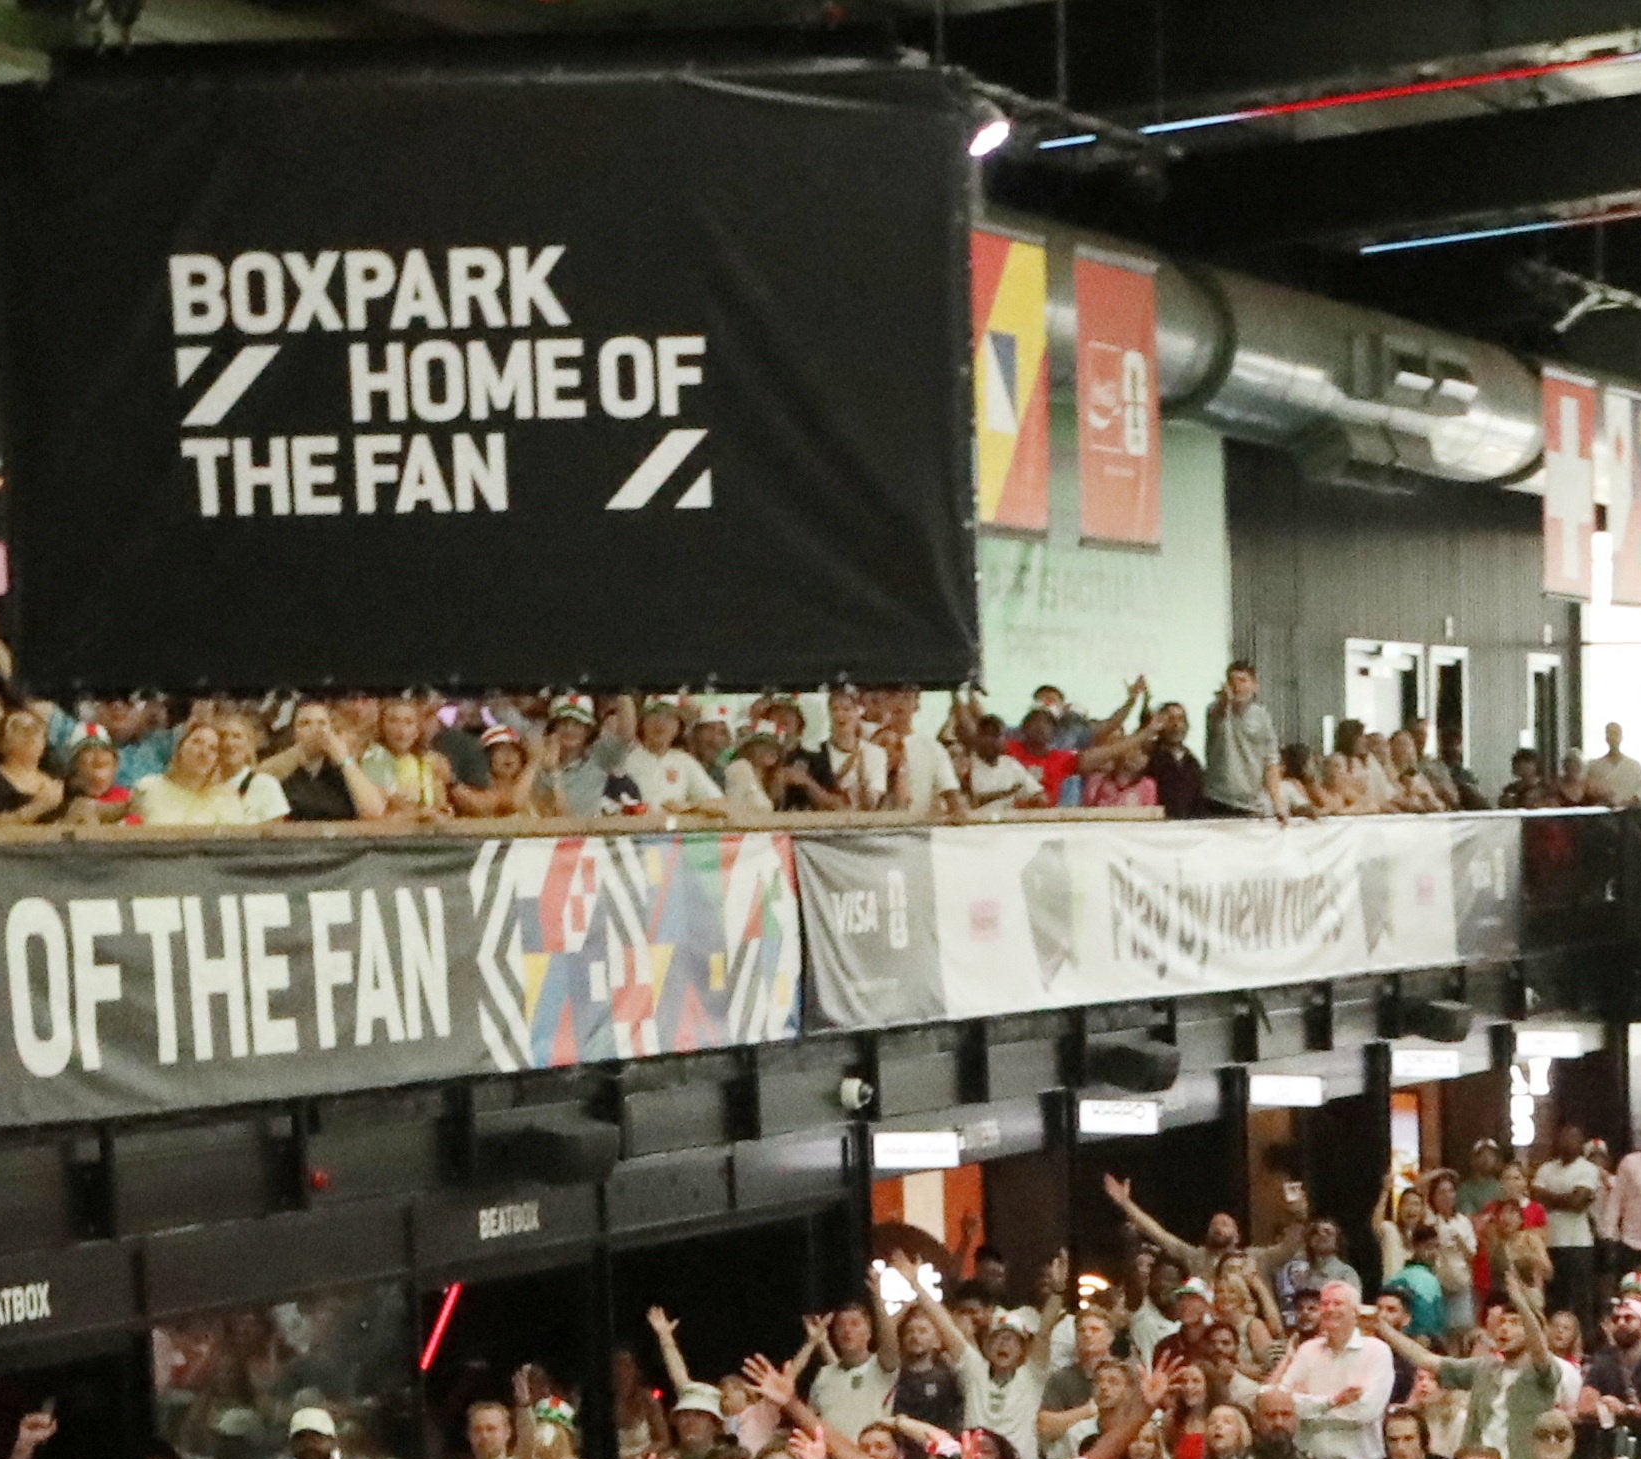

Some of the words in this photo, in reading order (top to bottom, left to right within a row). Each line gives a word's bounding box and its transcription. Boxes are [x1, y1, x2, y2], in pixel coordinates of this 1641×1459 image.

[168, 245, 572, 335] BOXPARK
[349, 338, 587, 423] HOME
[598, 335, 707, 420] OF
[180, 435, 342, 517] THE
[353, 432, 509, 514] FAN
[833, 890, 879, 934] VISA
[4, 896, 123, 1079] OF
[132, 892, 299, 1065] THE
[308, 886, 451, 1049] FAN
[479, 1201, 540, 1240] BEATBOX
